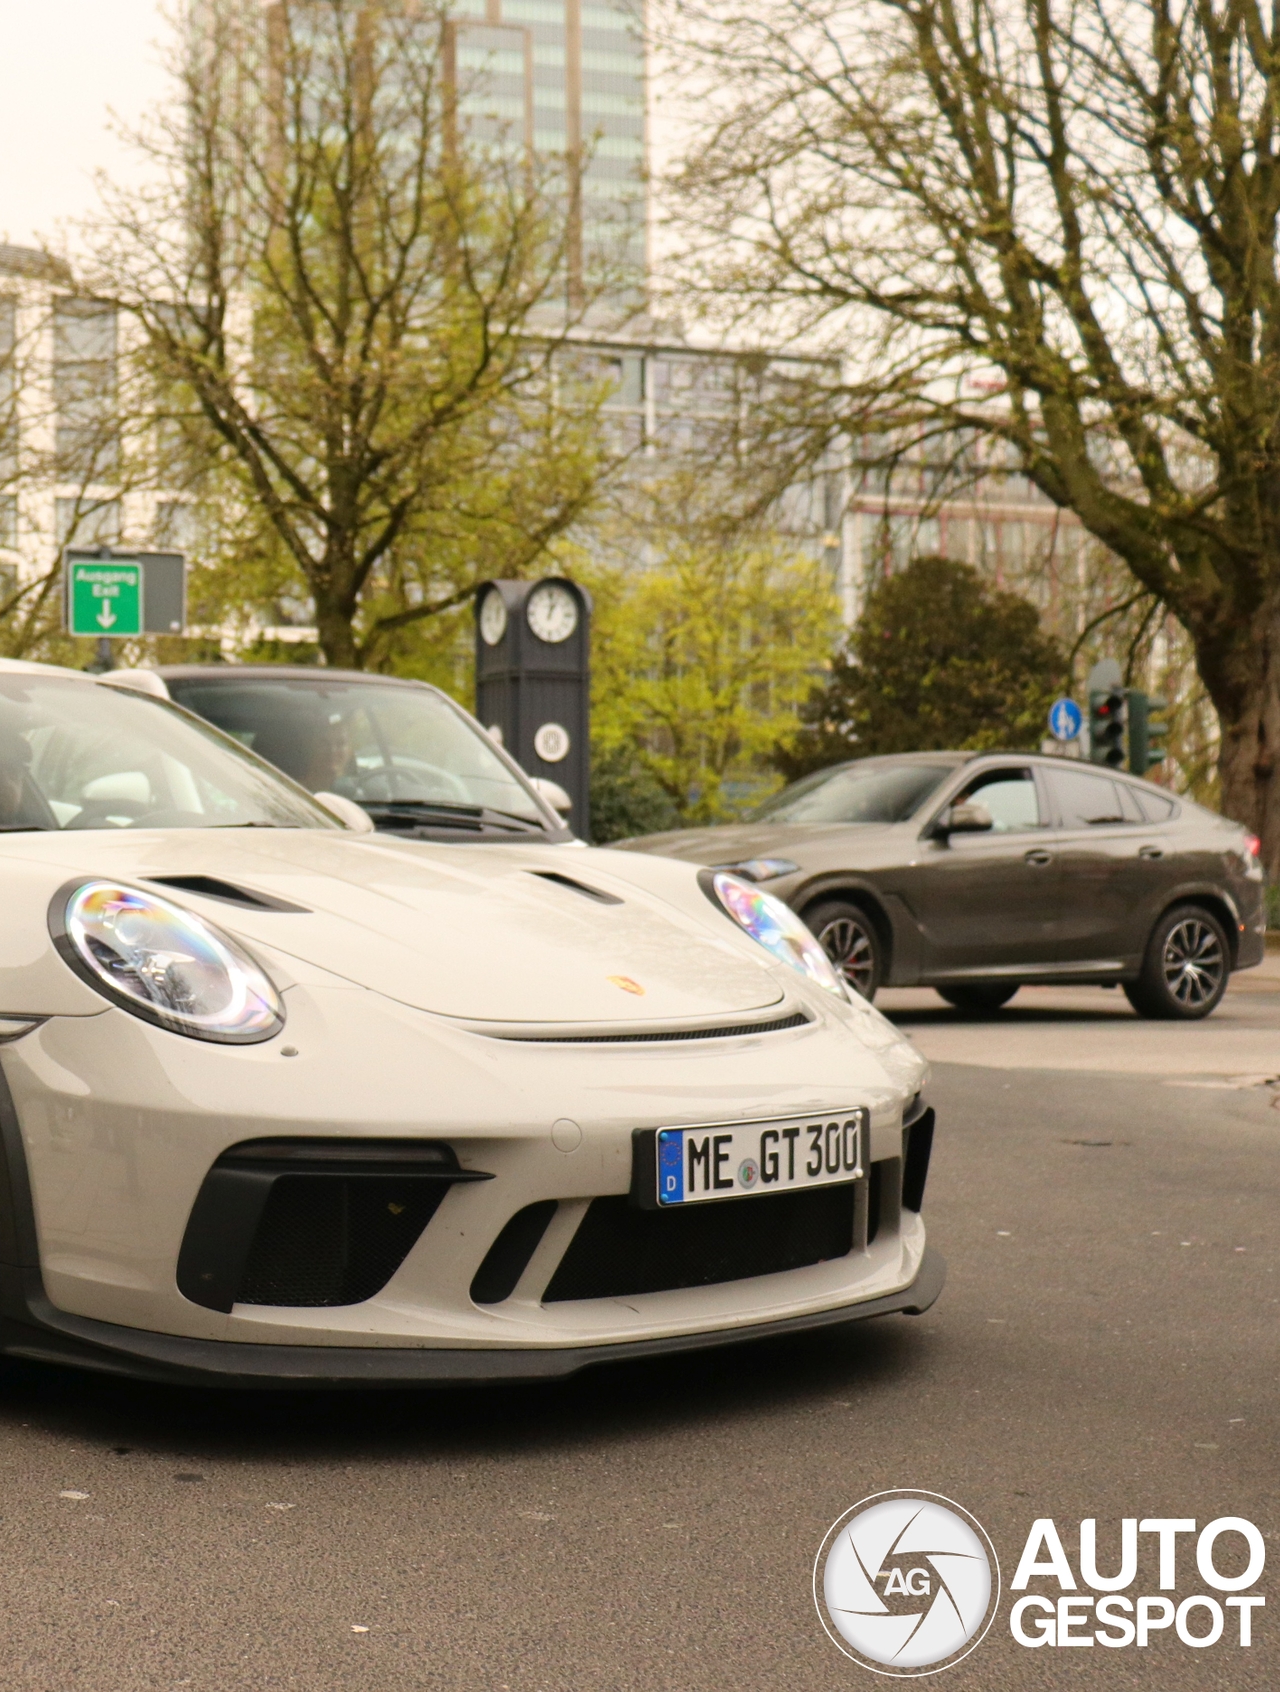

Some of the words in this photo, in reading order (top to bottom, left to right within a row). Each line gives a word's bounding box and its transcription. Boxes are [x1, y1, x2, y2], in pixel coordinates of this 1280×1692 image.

[76, 568, 137, 585] Ausgang
[92, 584, 120, 598] Exit
[687, 1134, 734, 1193] ME
[666, 1175, 676, 1192] D
